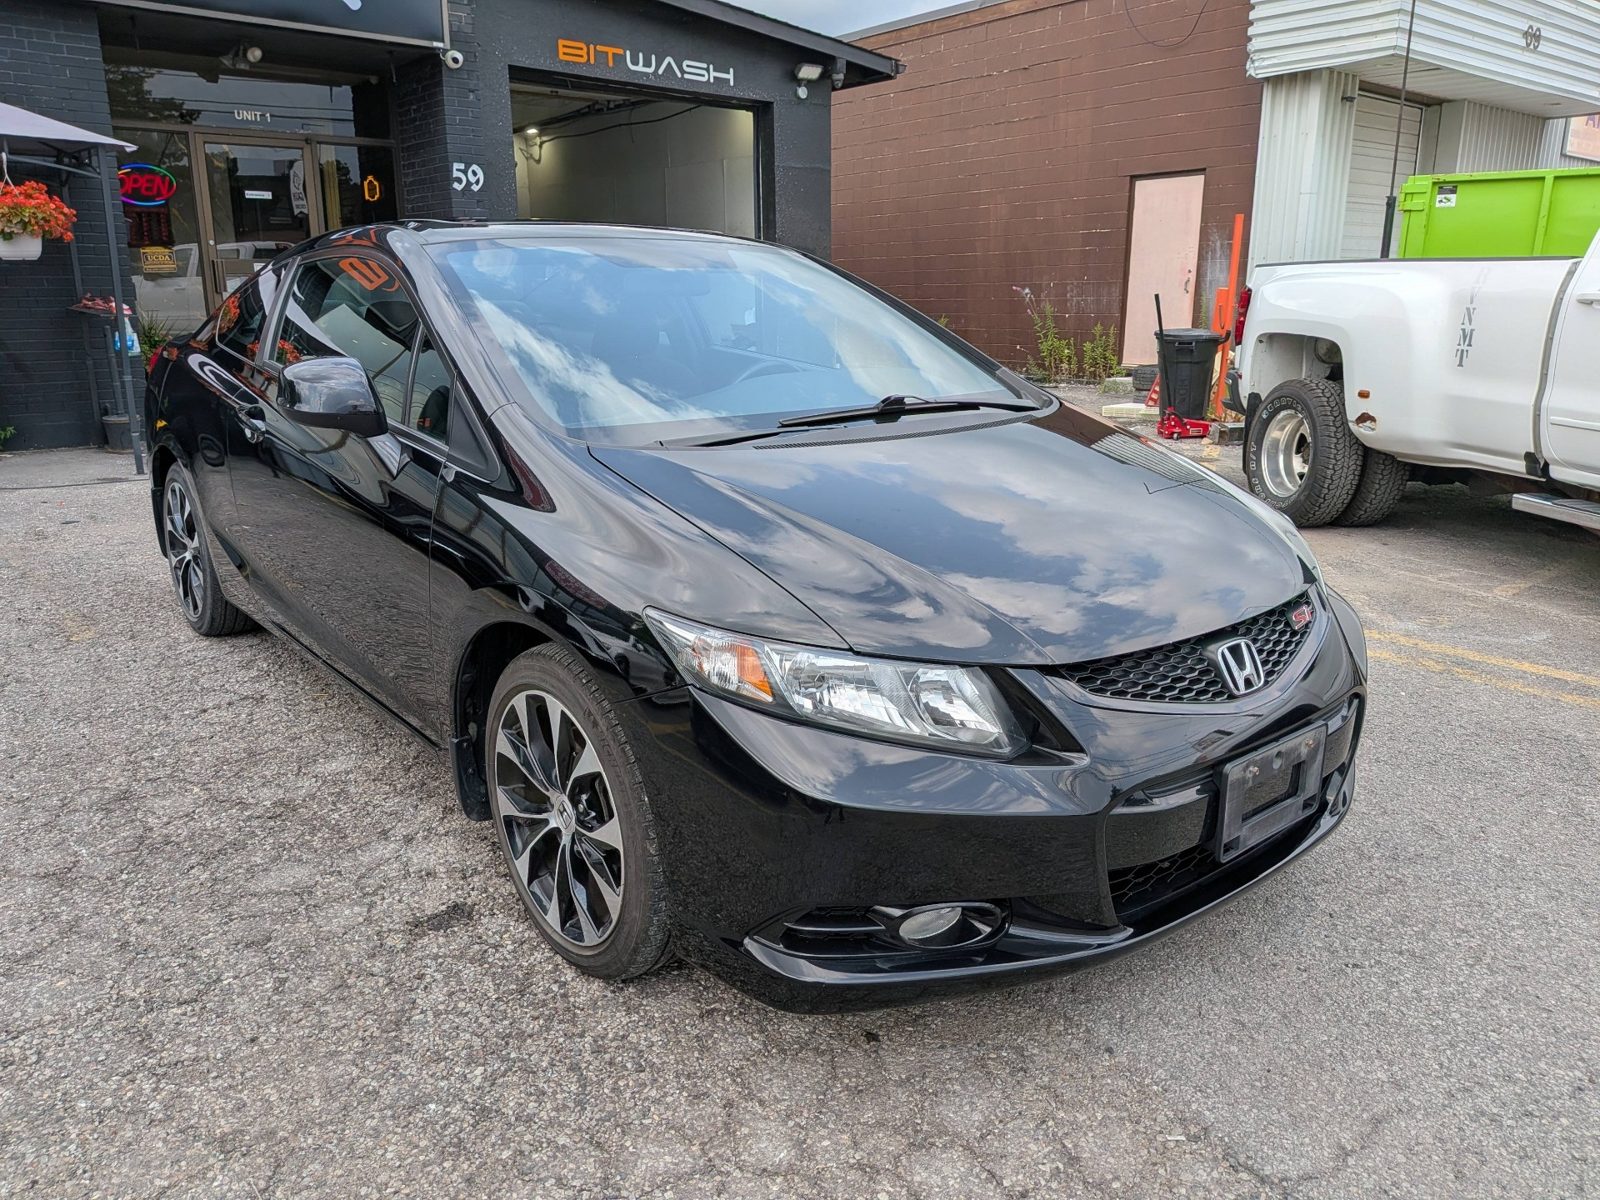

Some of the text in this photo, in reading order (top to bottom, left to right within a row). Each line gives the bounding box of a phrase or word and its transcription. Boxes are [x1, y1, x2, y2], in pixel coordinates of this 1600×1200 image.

[558, 38, 734, 87] BITWASH
[234, 109, 271, 123] UNIT 1
[118, 173, 170, 197] OPEN
[452, 162, 484, 192] 59
